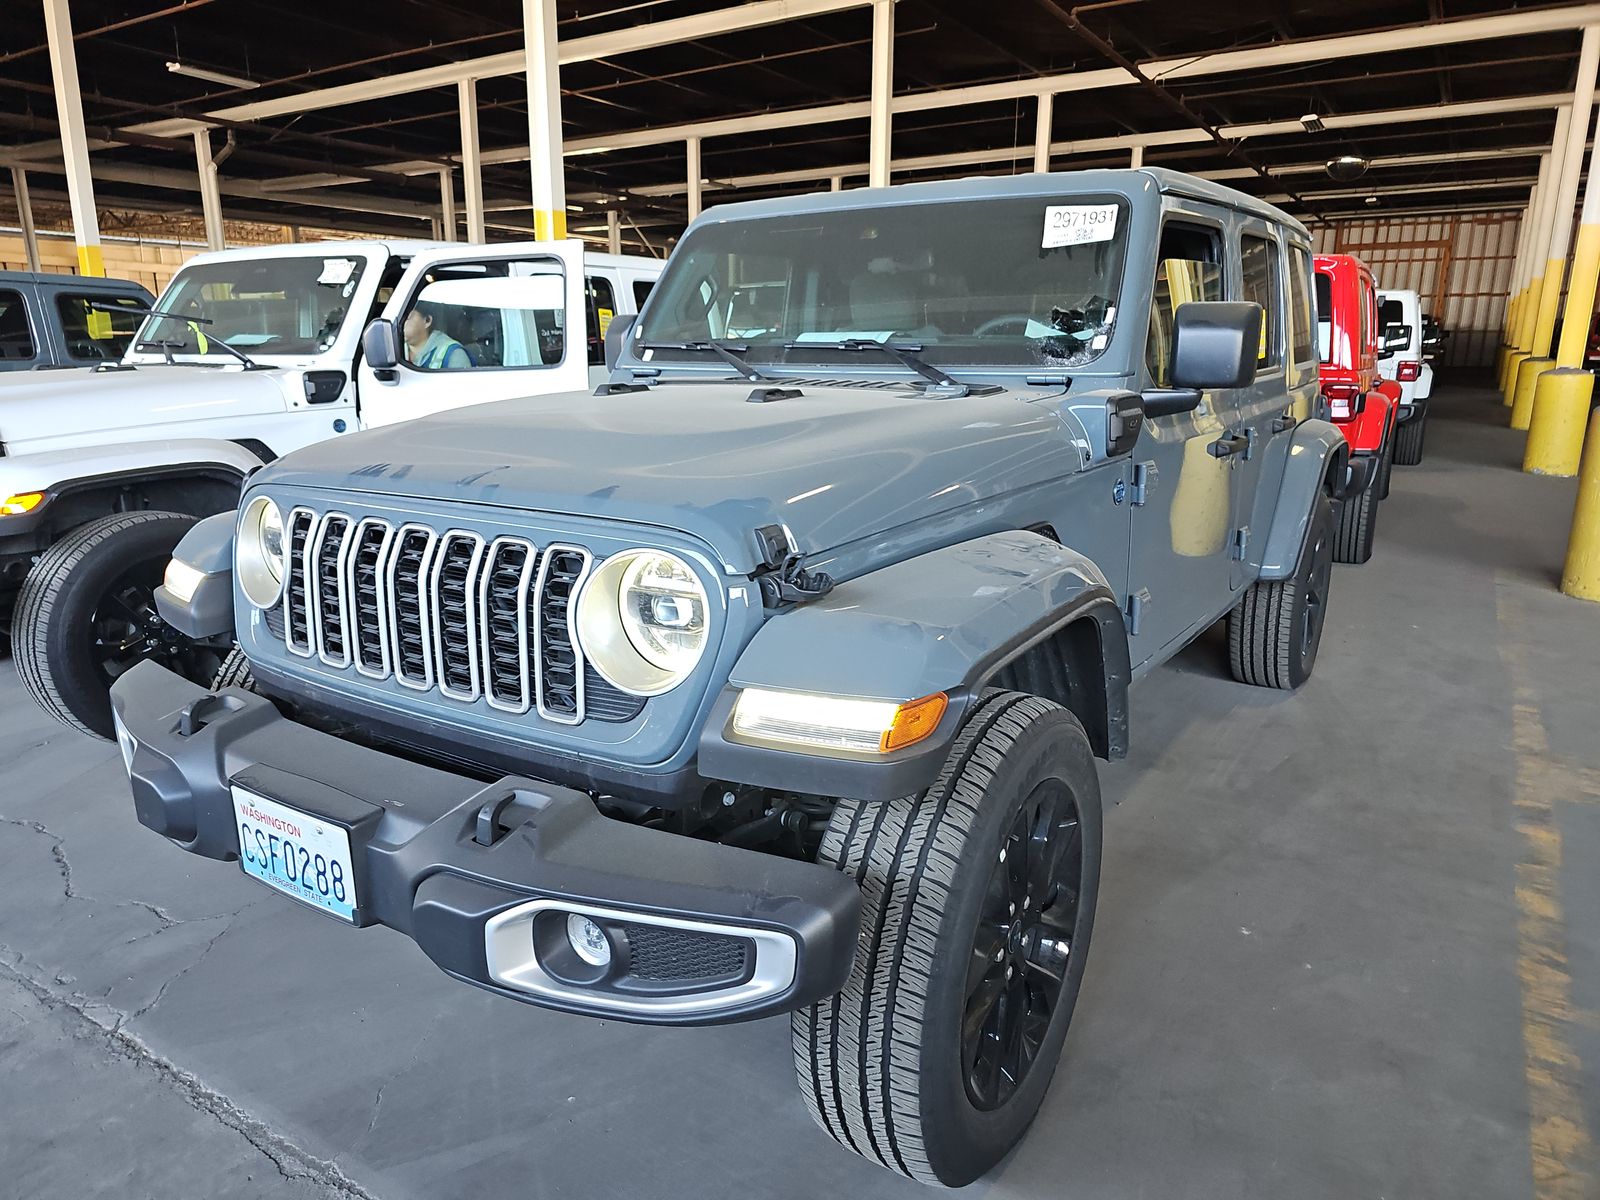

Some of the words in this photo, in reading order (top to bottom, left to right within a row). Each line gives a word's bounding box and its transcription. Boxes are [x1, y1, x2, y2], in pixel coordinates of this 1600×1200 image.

[1053, 210, 1114, 228] 2971931
[240, 803, 301, 838] WASHINGTON
[242, 822, 346, 903] CSF0288
[268, 873, 301, 893] EVERGREEN
[304, 889, 323, 903] STATE
